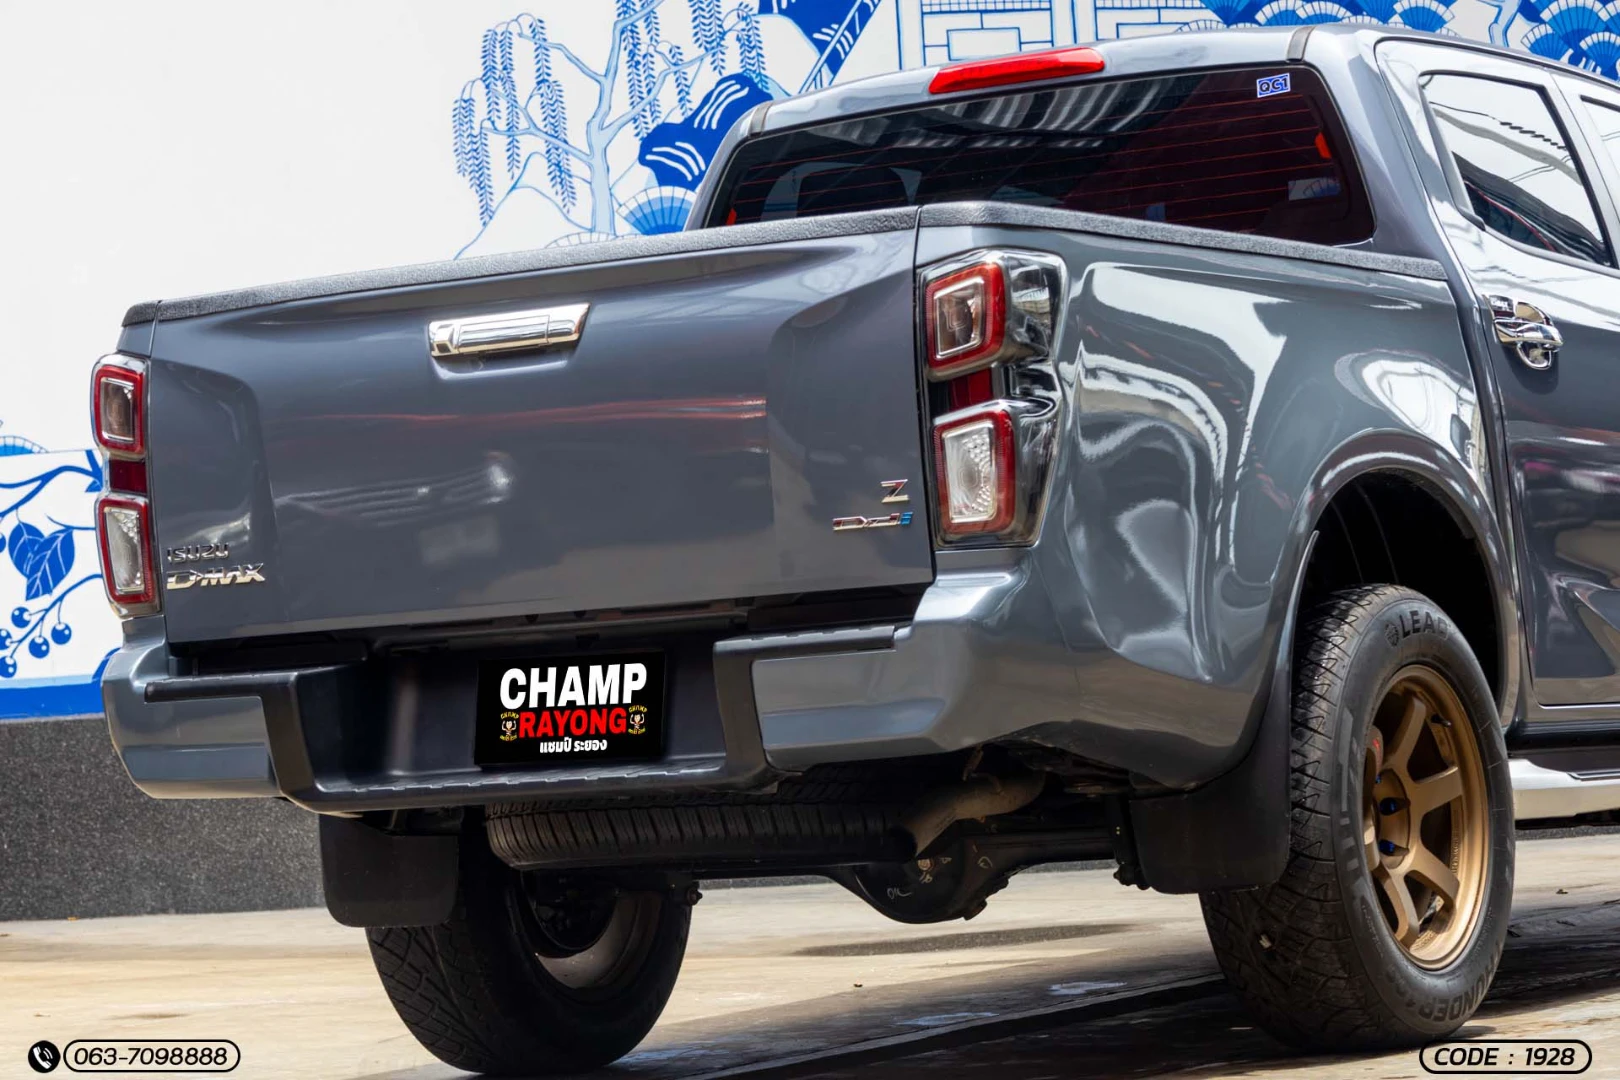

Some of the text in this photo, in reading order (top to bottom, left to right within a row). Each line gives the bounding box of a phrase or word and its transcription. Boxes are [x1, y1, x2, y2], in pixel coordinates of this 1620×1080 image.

[1259, 77, 1289, 93] QC1
[167, 543, 229, 562] ISUZU
[500, 662, 648, 710] CHAMP
[519, 707, 627, 738] RAYONG
